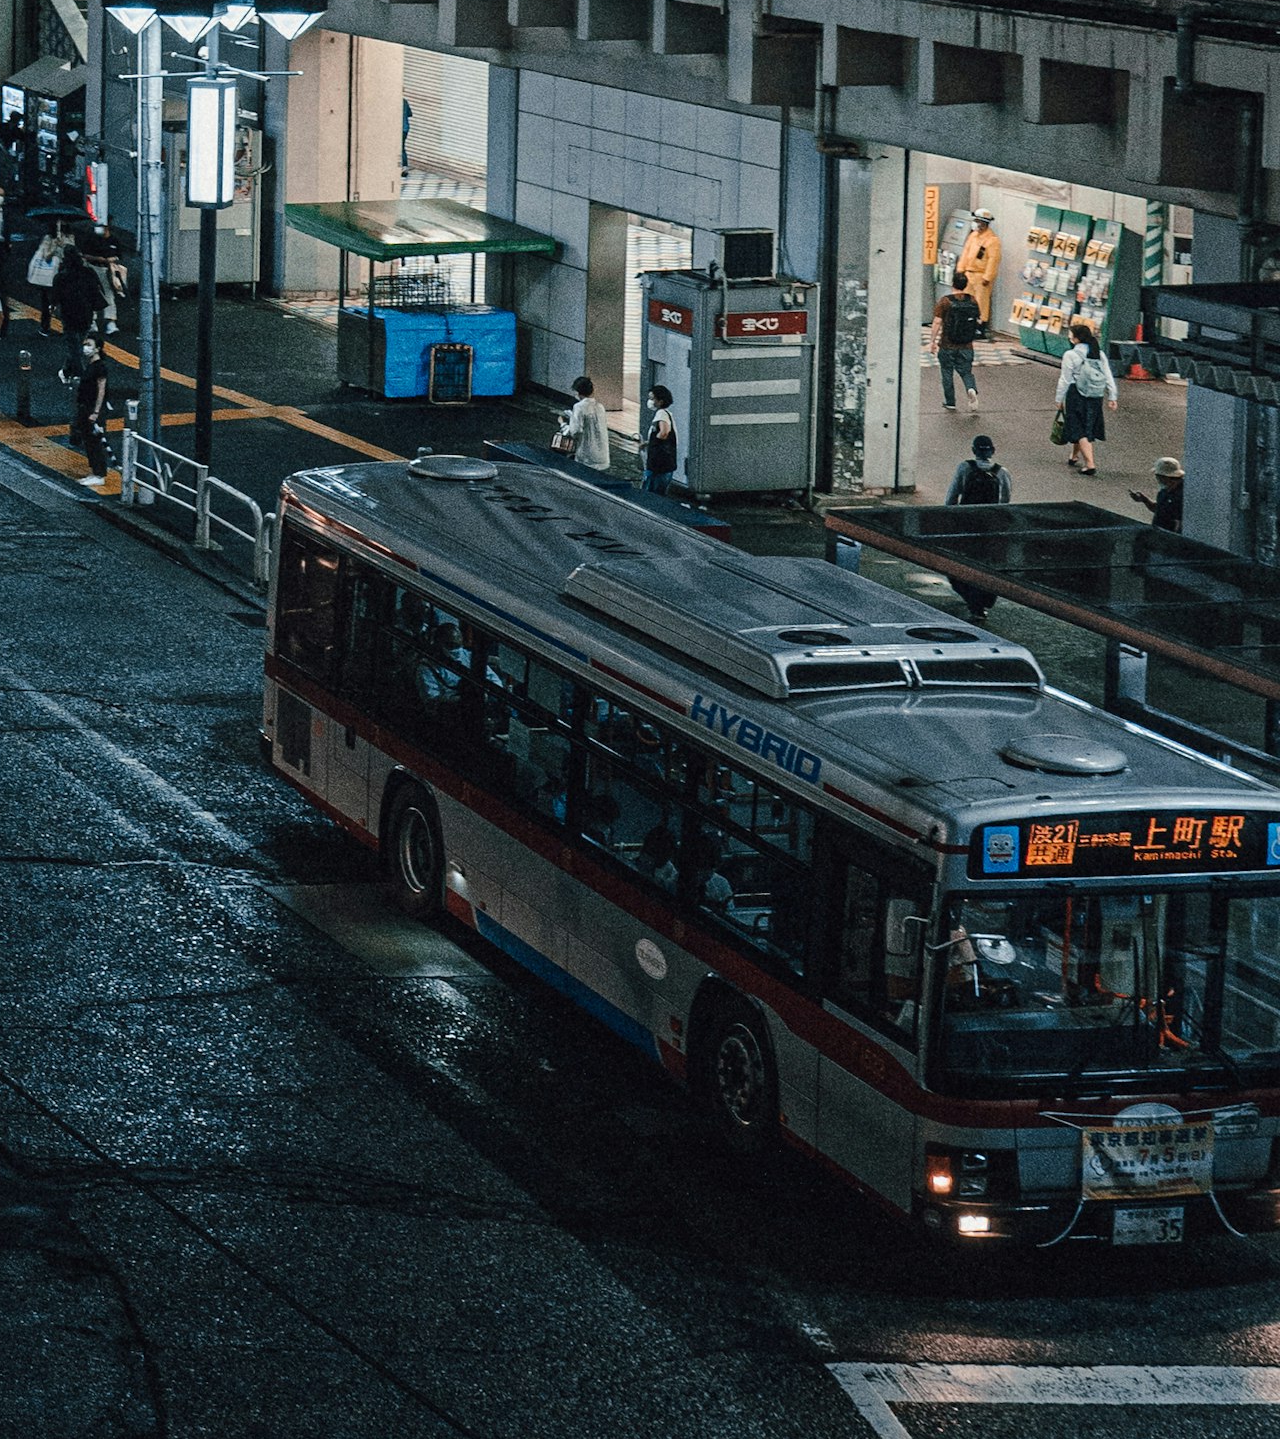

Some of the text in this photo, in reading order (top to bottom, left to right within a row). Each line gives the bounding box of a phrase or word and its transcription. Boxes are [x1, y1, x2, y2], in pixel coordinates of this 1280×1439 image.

[926, 189, 937, 260] コインロッカー
[691, 694, 823, 785] HYBRID
[1036, 822, 1077, 843] 渋21
[1133, 815, 1245, 850] 上町駅
[1031, 844, 1238, 864] 共通 Kamimachi Sta.
[1156, 1218, 1181, 1242] 35
